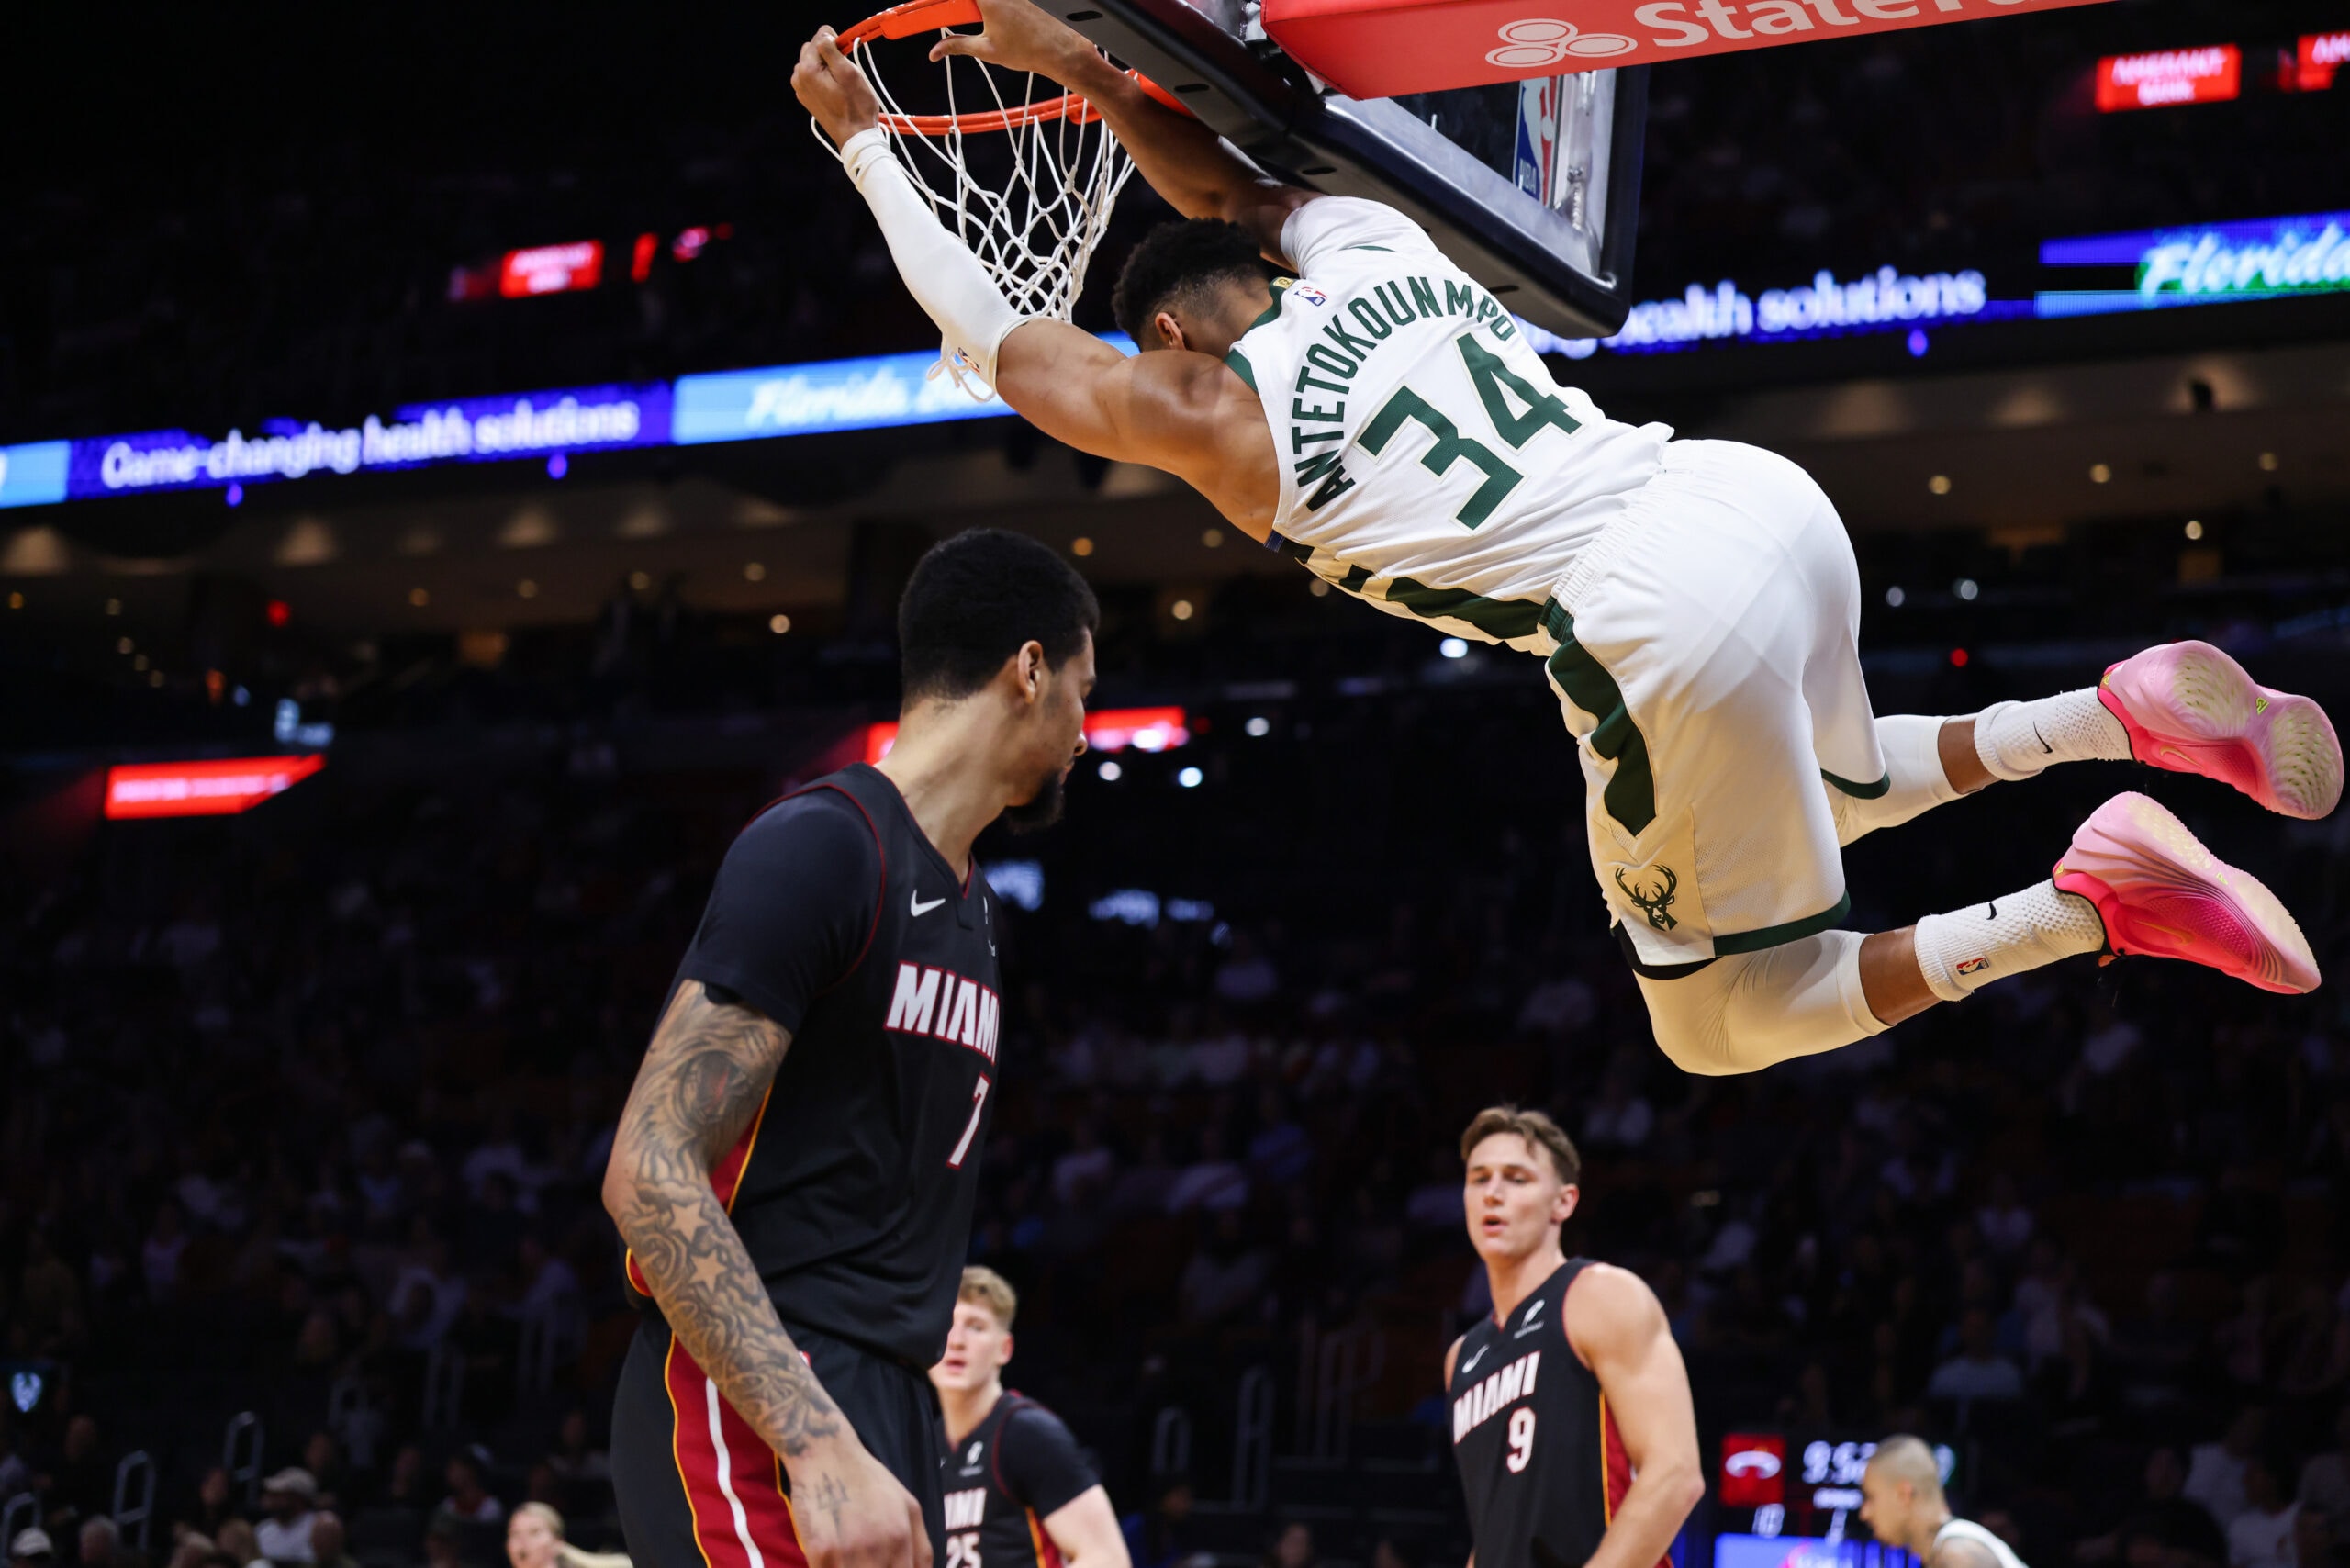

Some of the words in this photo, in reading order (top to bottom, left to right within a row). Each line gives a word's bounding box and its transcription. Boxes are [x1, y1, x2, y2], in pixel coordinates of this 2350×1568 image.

[1756, 265, 1986, 332] solutions
[1292, 277, 1516, 511] ANTETOKOUNMPO
[1353, 330, 1587, 532] 34
[101, 429, 361, 488] Game-changing
[364, 414, 472, 465] health
[474, 397, 640, 454] solutions
[946, 1070, 990, 1170] 7
[1453, 1350, 1541, 1446] MIAMI
[1506, 1406, 1536, 1474] 9
[945, 1531, 982, 1568] 25
